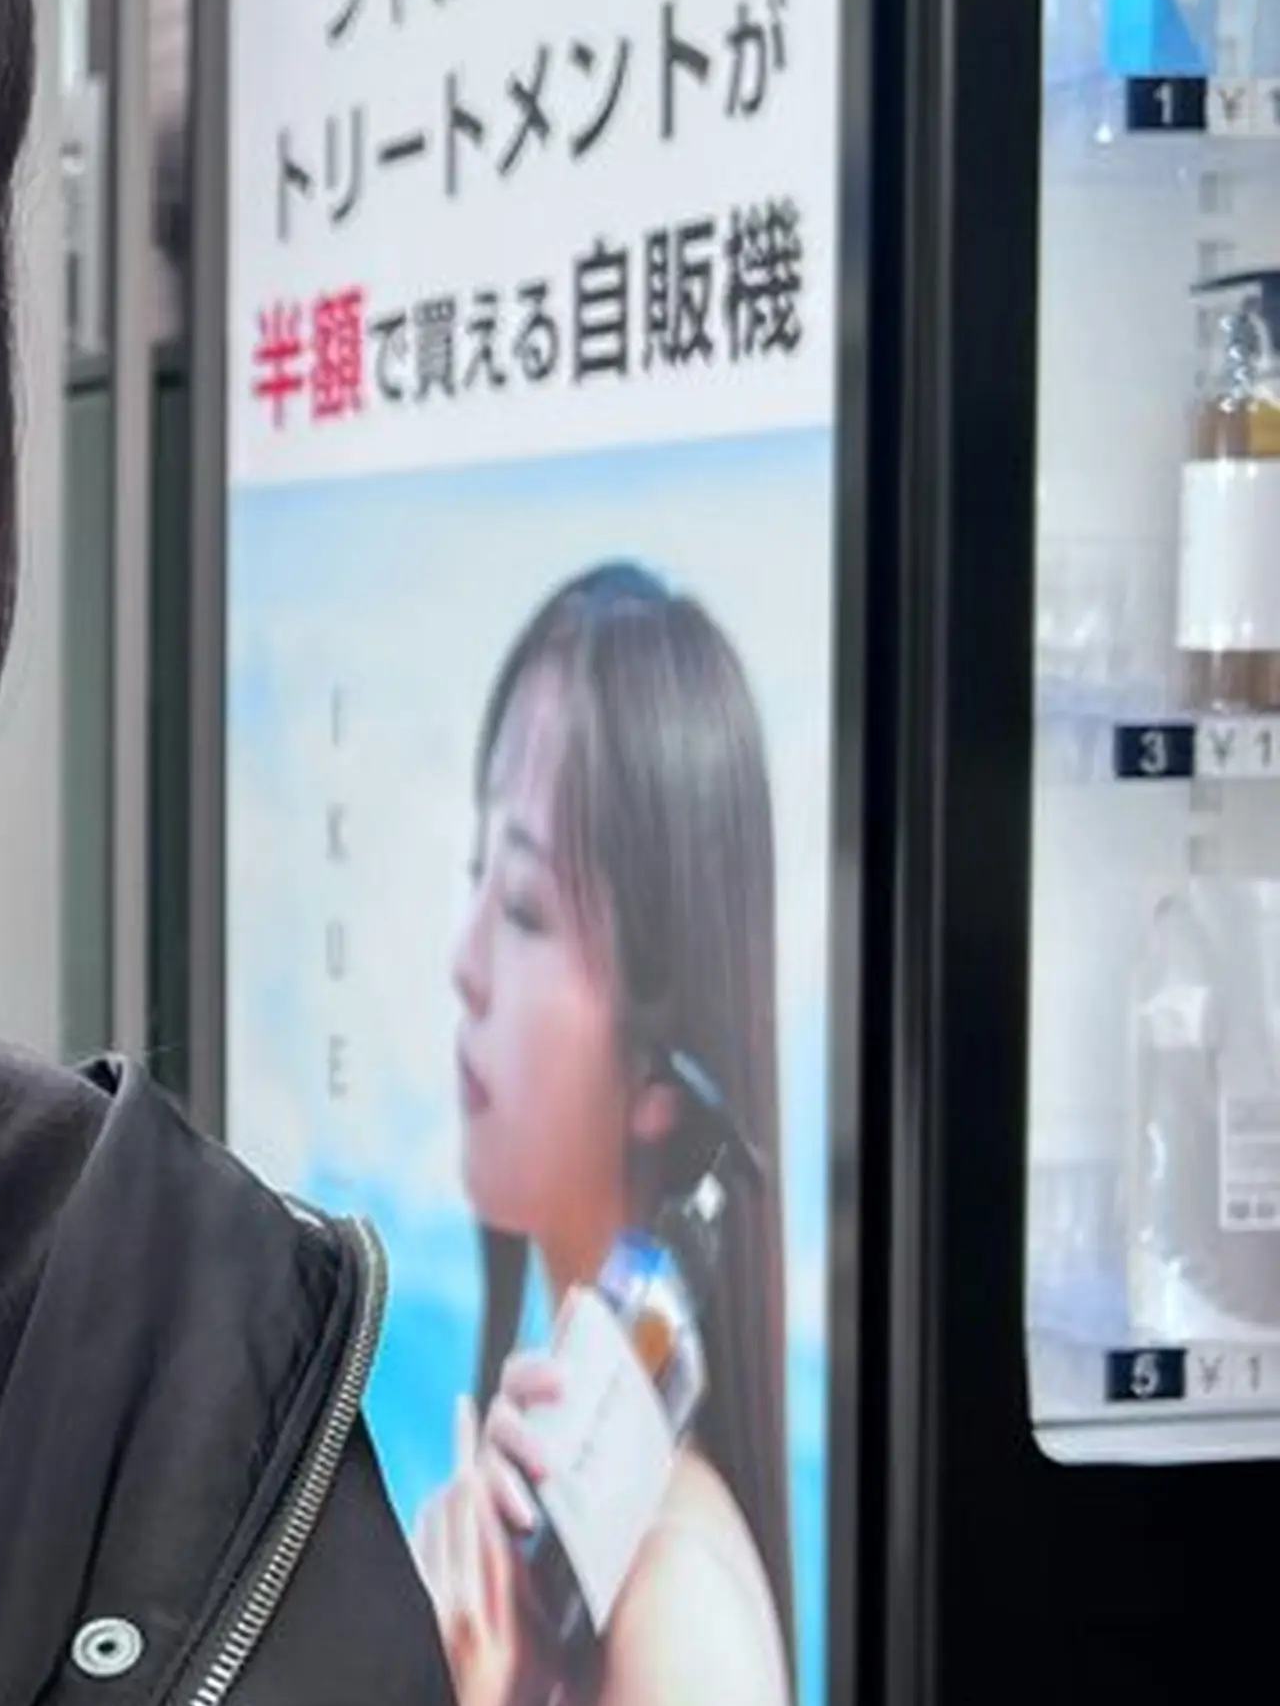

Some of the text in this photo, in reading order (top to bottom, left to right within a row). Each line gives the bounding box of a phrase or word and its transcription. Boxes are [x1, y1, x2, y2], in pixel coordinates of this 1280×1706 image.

[1152, 81, 1173, 125] 1
[253, 193, 803, 433] 半額で買える自販機
[1139, 729, 1167, 774] 3
